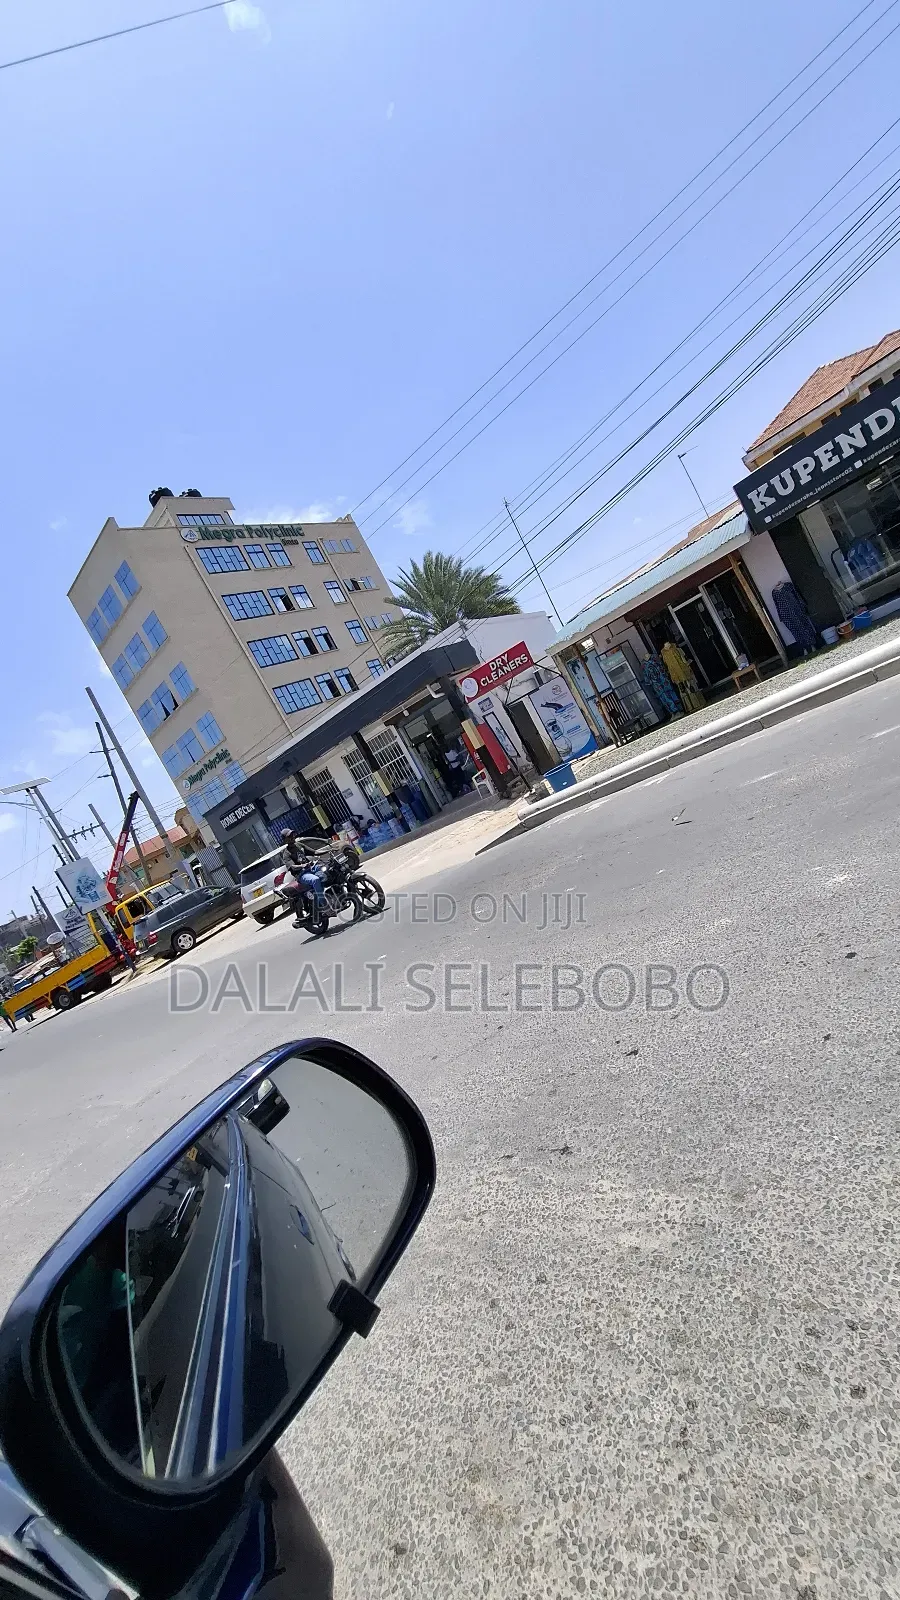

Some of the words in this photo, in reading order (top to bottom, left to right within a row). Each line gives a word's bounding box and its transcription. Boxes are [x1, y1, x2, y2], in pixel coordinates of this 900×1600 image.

[198, 525, 246, 542] Megra
[243, 523, 305, 540] Polyclinic
[480, 653, 529, 686] CLEANERS
[489, 653, 509, 671] DRY
[220, 812, 237, 829] HOME
